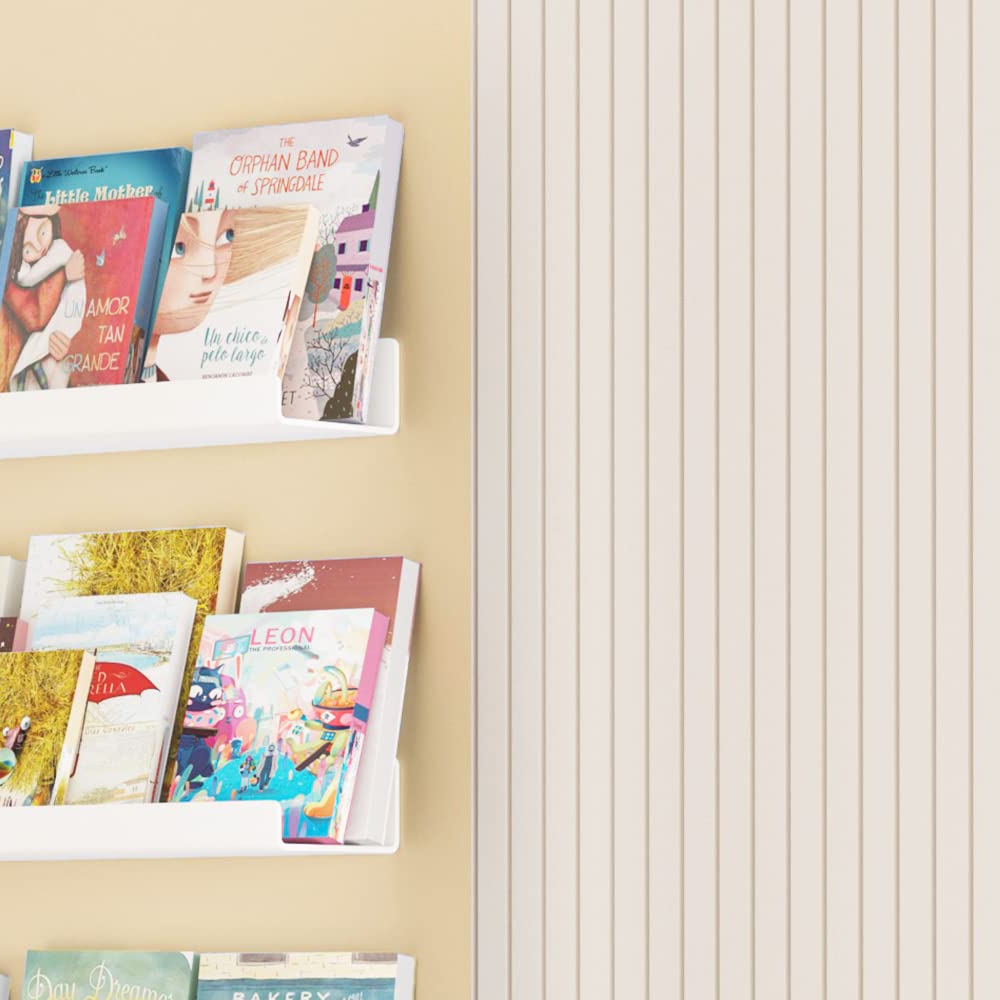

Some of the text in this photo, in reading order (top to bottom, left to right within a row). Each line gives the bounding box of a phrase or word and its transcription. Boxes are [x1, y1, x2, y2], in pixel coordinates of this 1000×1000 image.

[279, 136, 295, 147] THE
[229, 148, 339, 176] ORPHAN BAND
[45, 189, 89, 206] Little
[94, 184, 153, 201] Mother
[237, 173, 326, 196] of SPRINGDALE
[64, 296, 130, 319] UN AMOR
[98, 324, 125, 344] TAN
[203, 327, 221, 347] Un
[226, 326, 260, 345] chico
[62, 352, 121, 374] GRANDE
[200, 345, 265, 369] pelo largo
[250, 625, 315, 645] LEON
